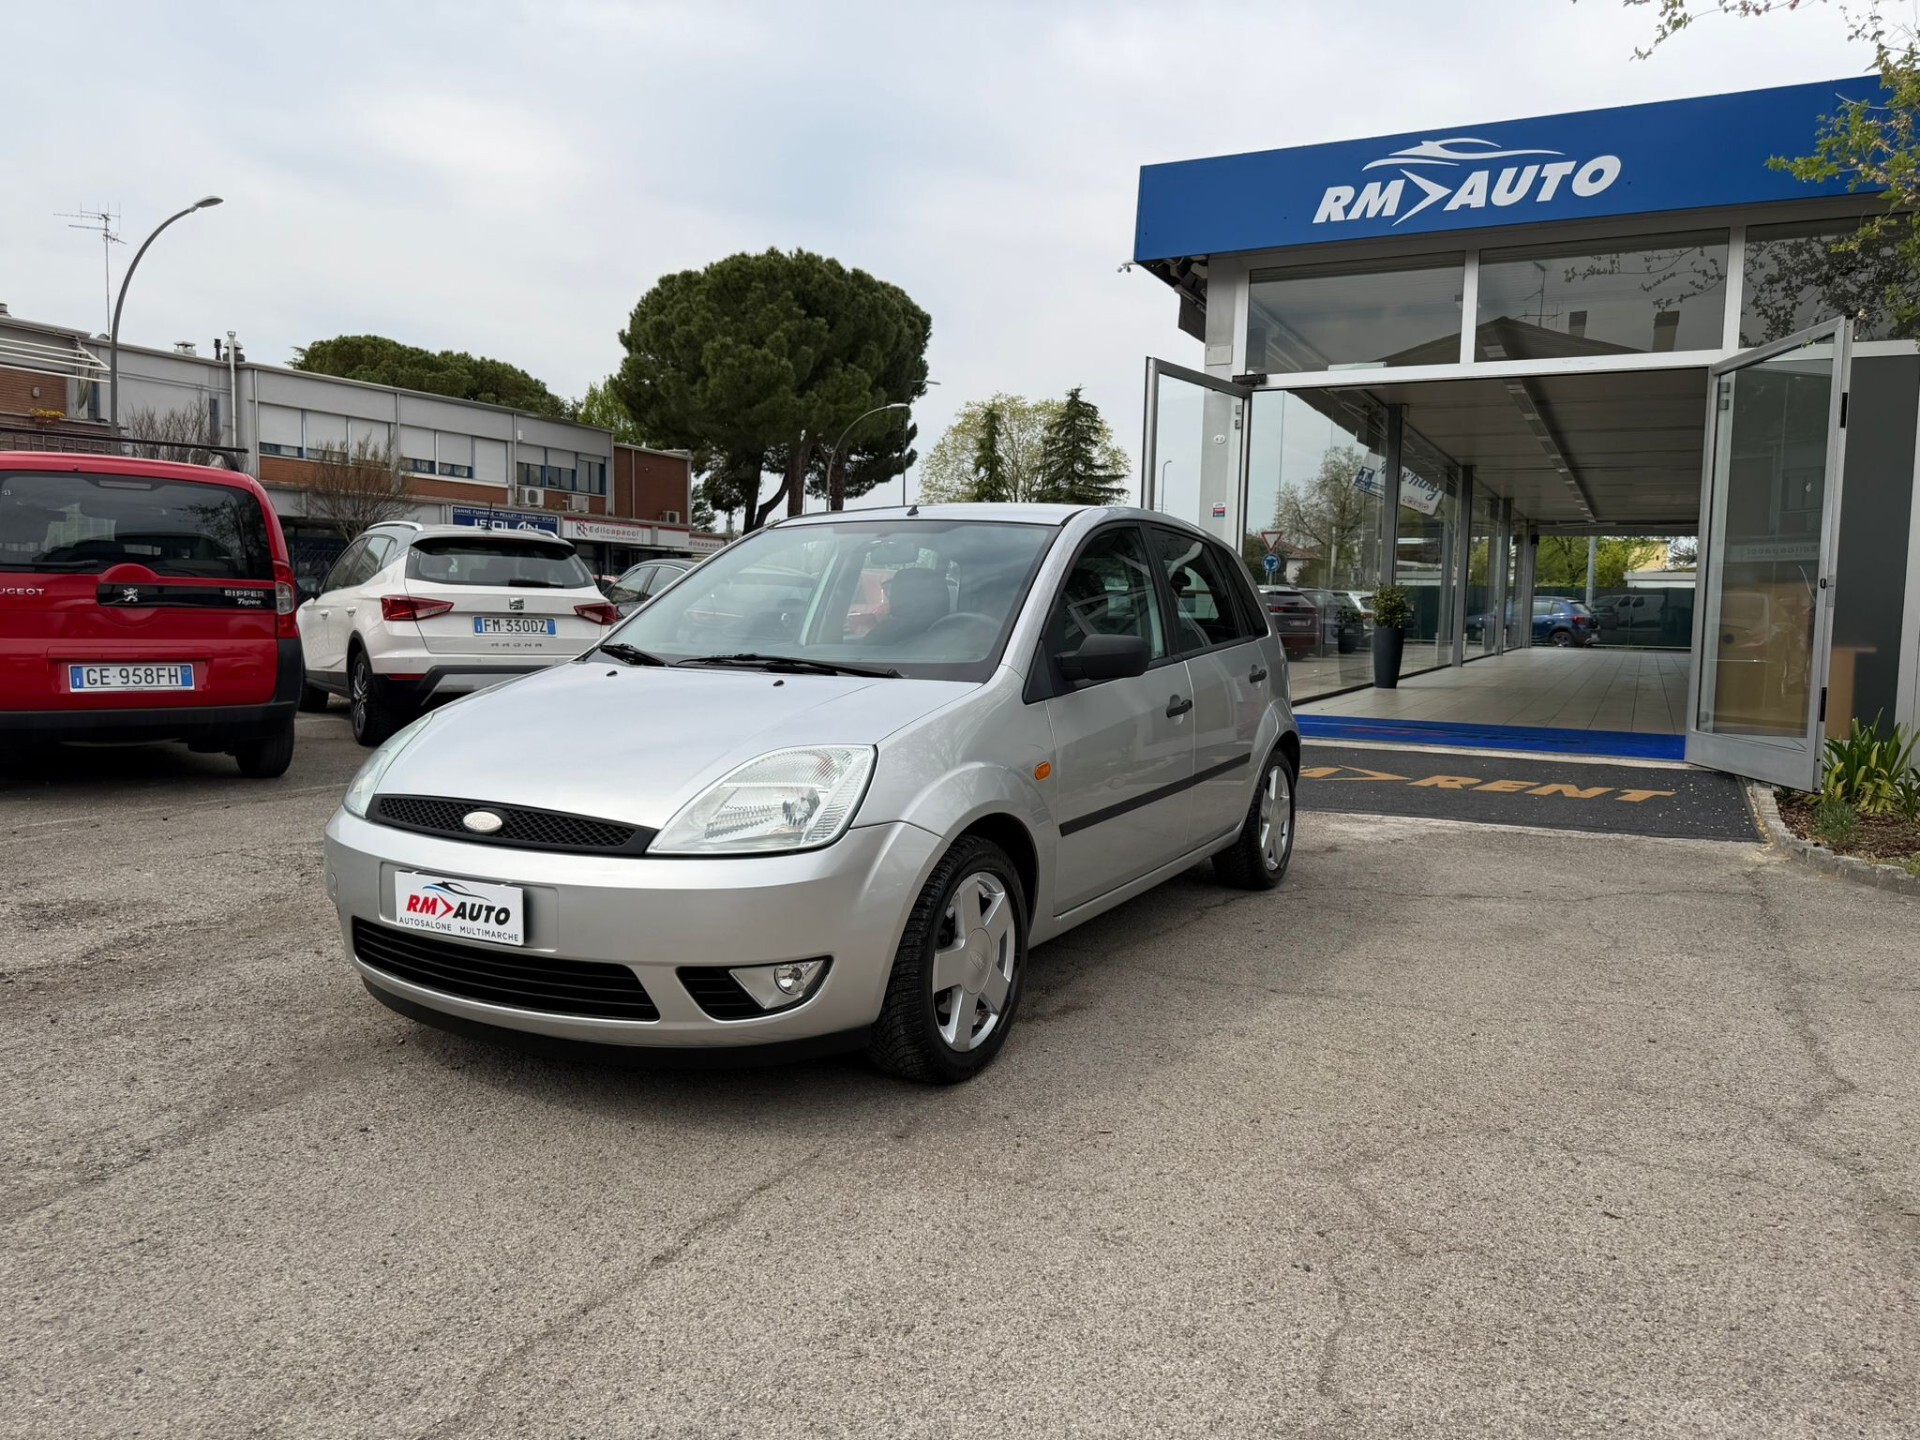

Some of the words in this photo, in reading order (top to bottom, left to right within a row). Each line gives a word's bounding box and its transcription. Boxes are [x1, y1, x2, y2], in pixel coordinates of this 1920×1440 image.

[1312, 179, 1406, 224] RM
[1443, 155, 1622, 211] AUTO
[484, 619, 501, 632] FM
[86, 668, 111, 686] GE
[119, 667, 179, 685] 958FH
[1408, 775, 1677, 803] RENT
[406, 894, 438, 916] RM
[453, 901, 511, 926] AUTO
[399, 916, 452, 932] AUTOSALONE
[459, 925, 519, 942] MULTIMARCHE
